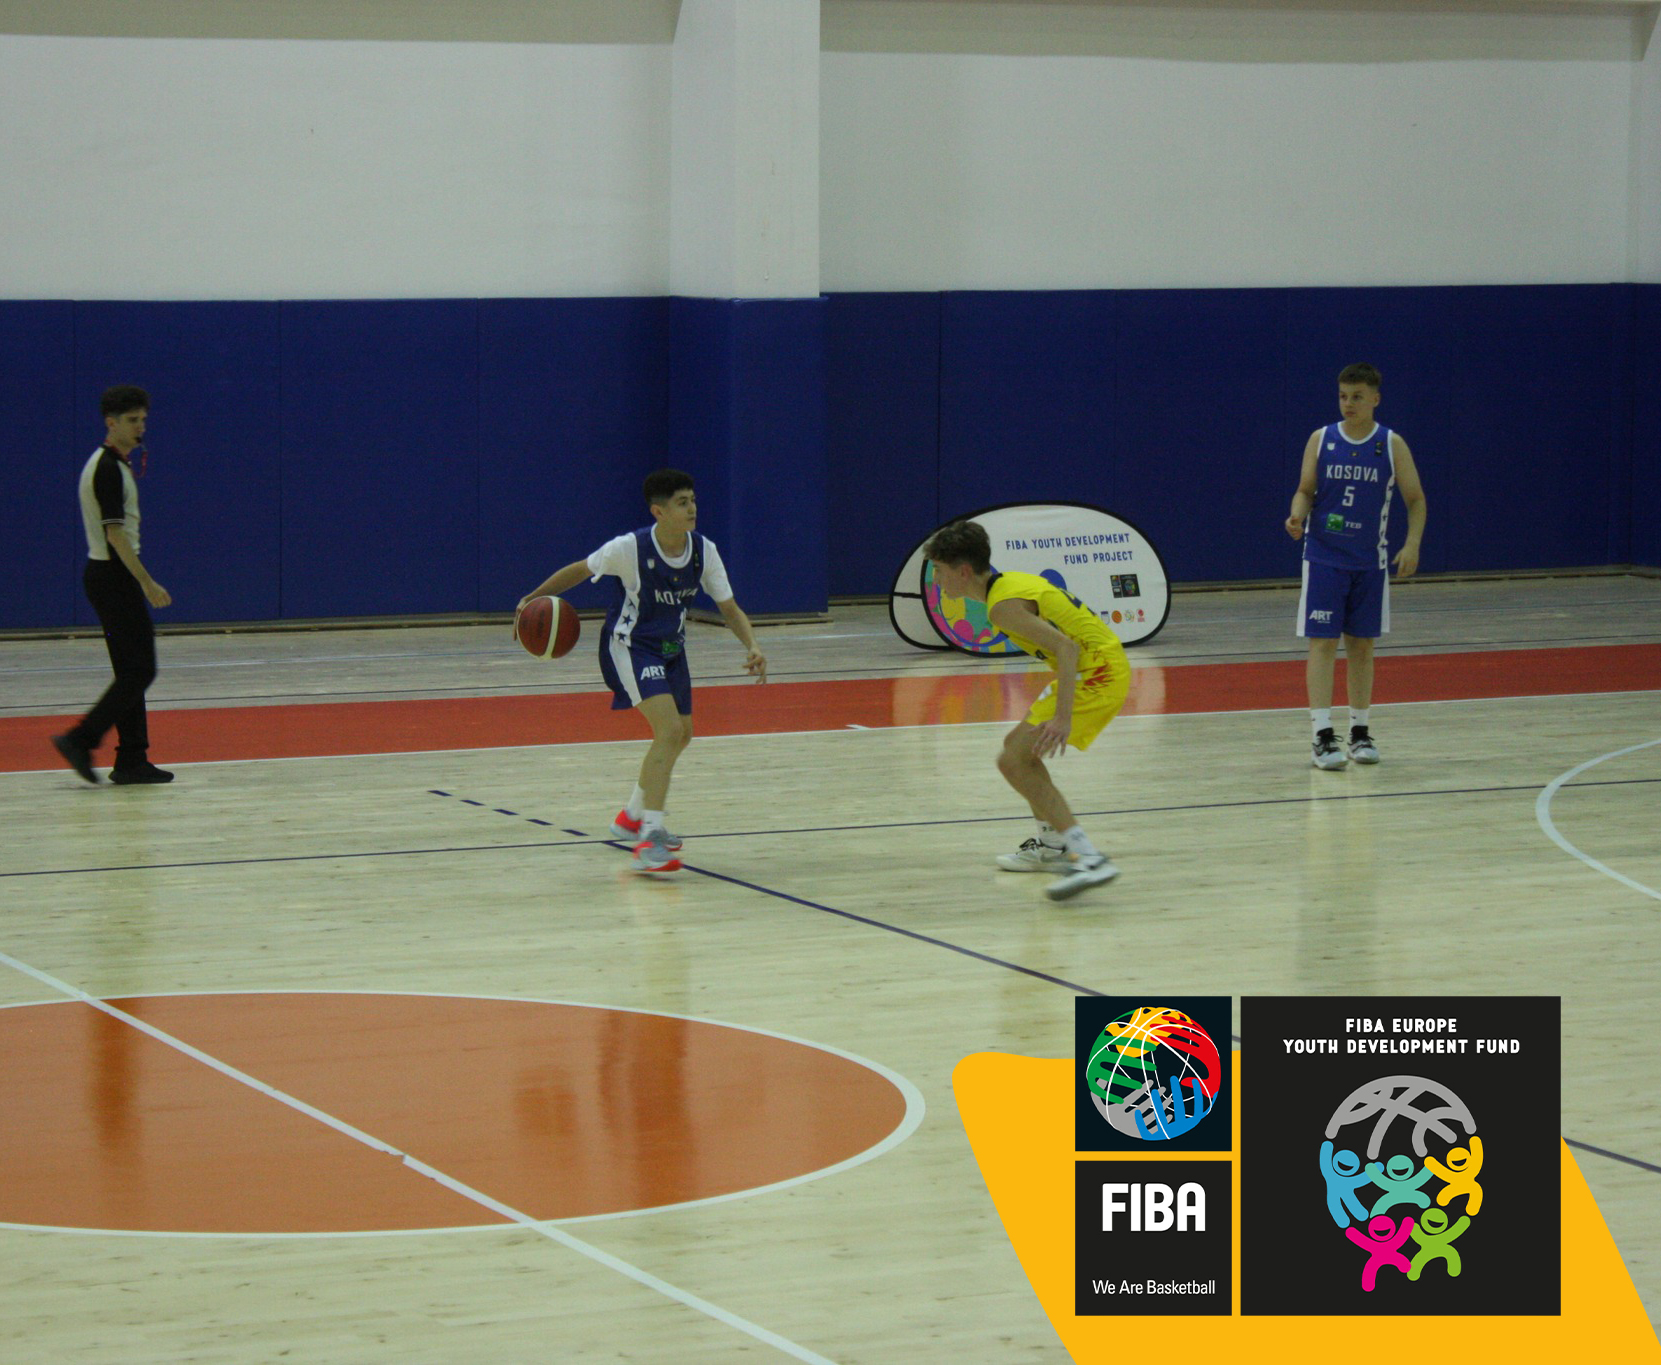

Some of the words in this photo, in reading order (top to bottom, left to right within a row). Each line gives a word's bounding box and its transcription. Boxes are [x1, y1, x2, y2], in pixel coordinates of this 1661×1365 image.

[1326, 464, 1378, 483] KOSOVA
[1342, 486, 1355, 507] 5
[1005, 540, 1028, 551] FIBA
[1032, 537, 1062, 549] YOUTH
[1065, 533, 1130, 547] DEVELOPMENT
[1064, 553, 1088, 565] FUND
[1093, 551, 1133, 563] PROJECT
[1309, 610, 1333, 620] ART
[641, 665, 666, 680] ART
